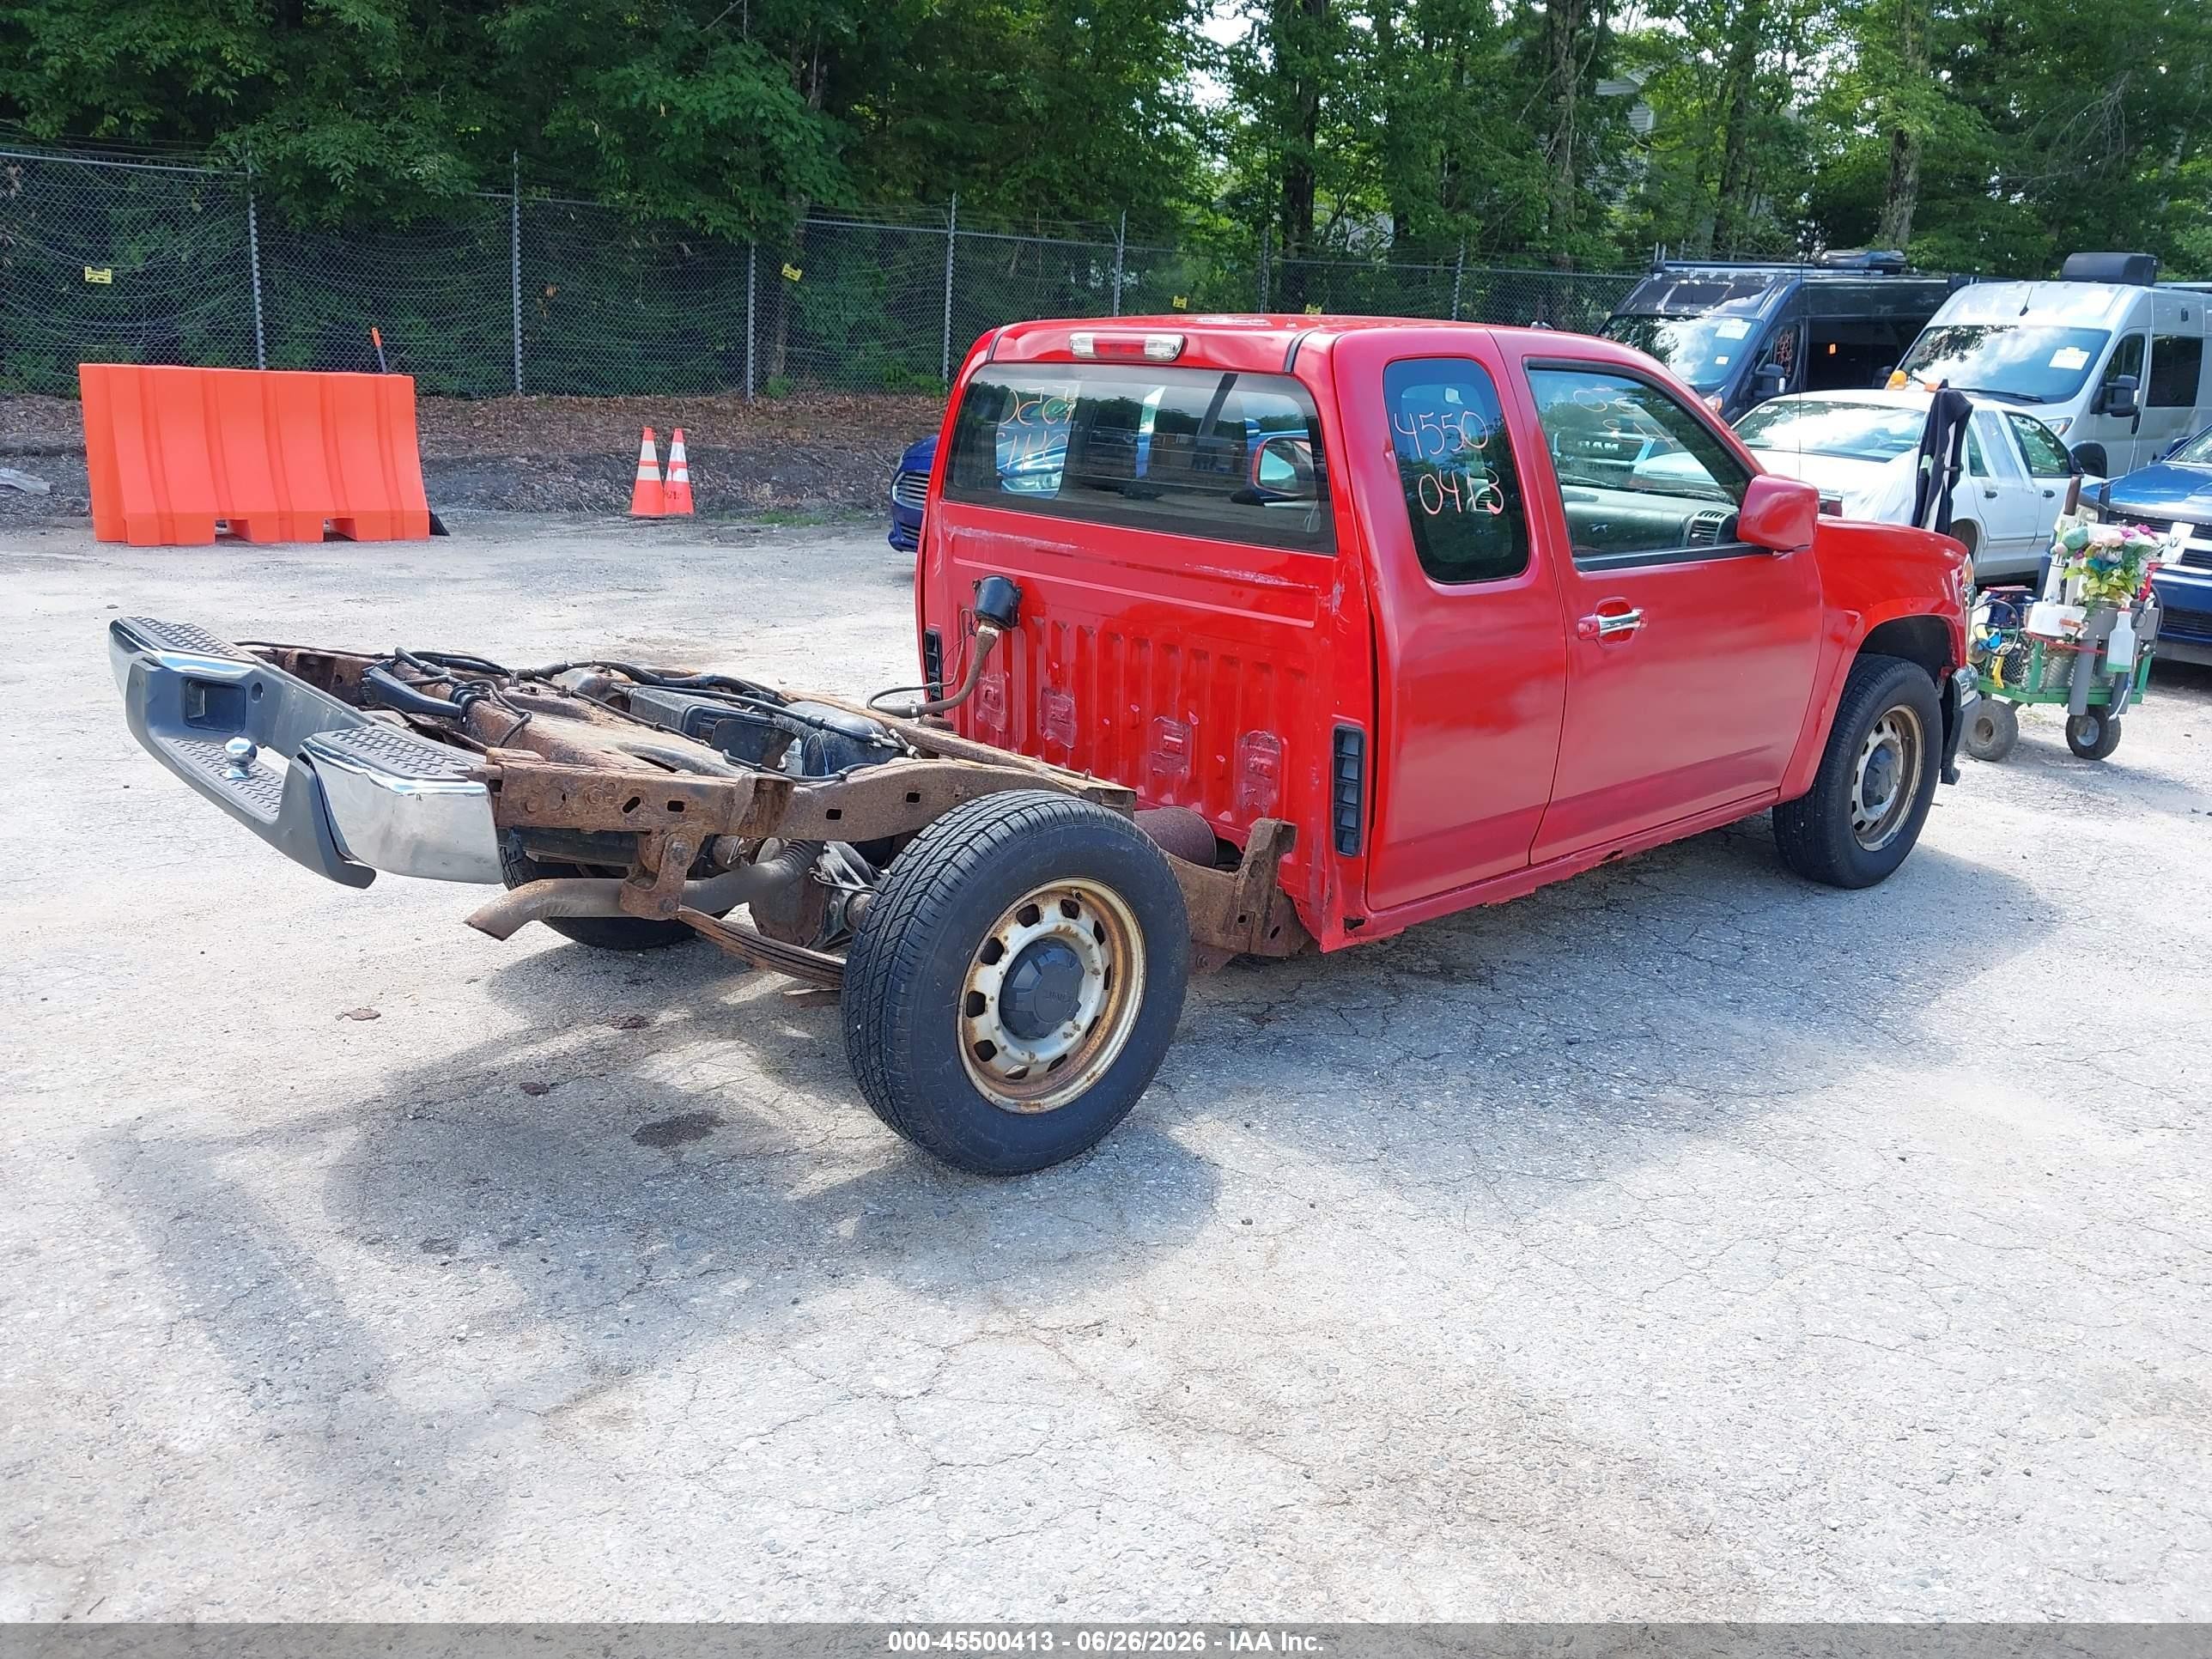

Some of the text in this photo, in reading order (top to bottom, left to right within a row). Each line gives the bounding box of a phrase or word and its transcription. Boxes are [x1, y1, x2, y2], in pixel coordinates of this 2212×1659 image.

[1395, 411, 1488, 459] 4550
[1577, 441, 1620, 452] RAM
[1419, 467, 1504, 514] 0413
